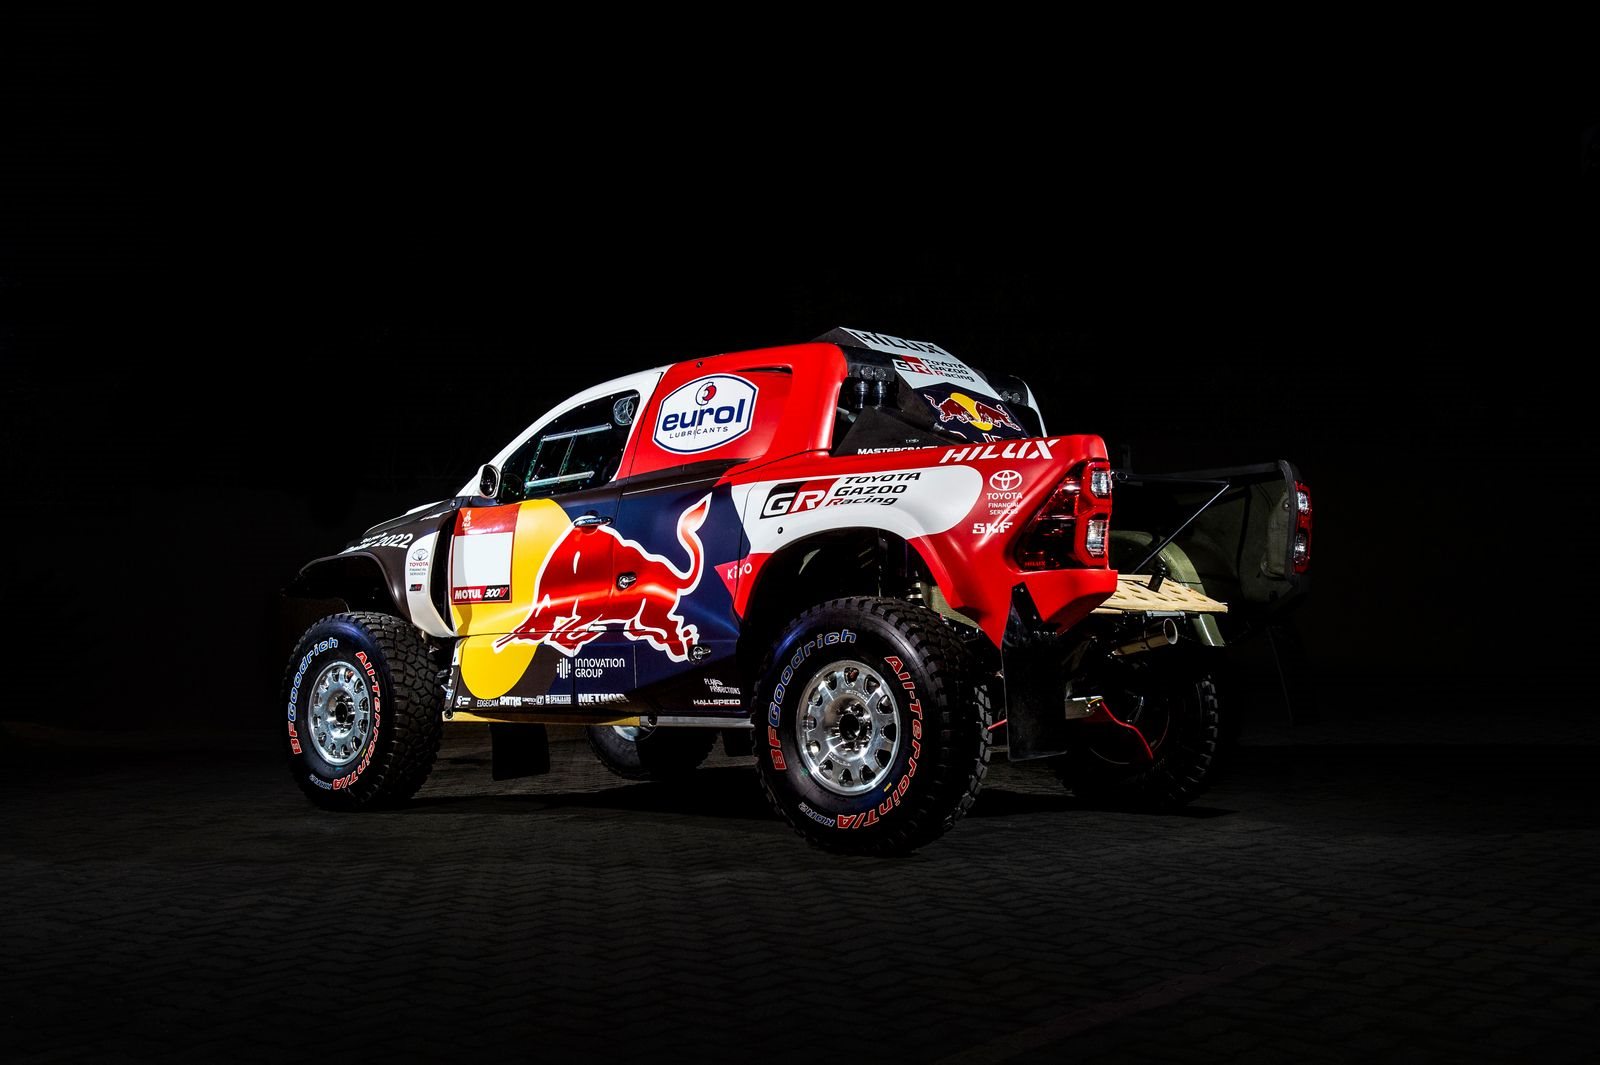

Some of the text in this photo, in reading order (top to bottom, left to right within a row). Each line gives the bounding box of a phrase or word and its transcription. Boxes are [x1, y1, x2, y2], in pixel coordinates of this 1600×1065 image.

[849, 332, 946, 355] HILUX
[894, 360, 933, 376] GR
[920, 358, 968, 370] TOYOTA
[929, 365, 969, 376] GAZOO
[935, 370, 975, 382] Racing
[662, 398, 746, 431] eurol
[669, 426, 729, 439] LUBRICANTS
[939, 438, 1061, 464] HILUX
[844, 471, 921, 485] TOYOTA
[834, 484, 908, 496] GAZOO
[986, 492, 1023, 500] TOYOTA
[761, 487, 829, 518] GR
[824, 495, 898, 507] Racing
[972, 522, 1014, 534] SKF
[371, 533, 413, 549] 2022
[454, 586, 509, 600] MOTUL 300V
[574, 657, 626, 669] INNOVATION
[574, 669, 604, 679] GROUP
[287, 637, 338, 755] BFGoodrich
[767, 629, 857, 771] BFGoodrich
[476, 699, 499, 708] EDGECAM
